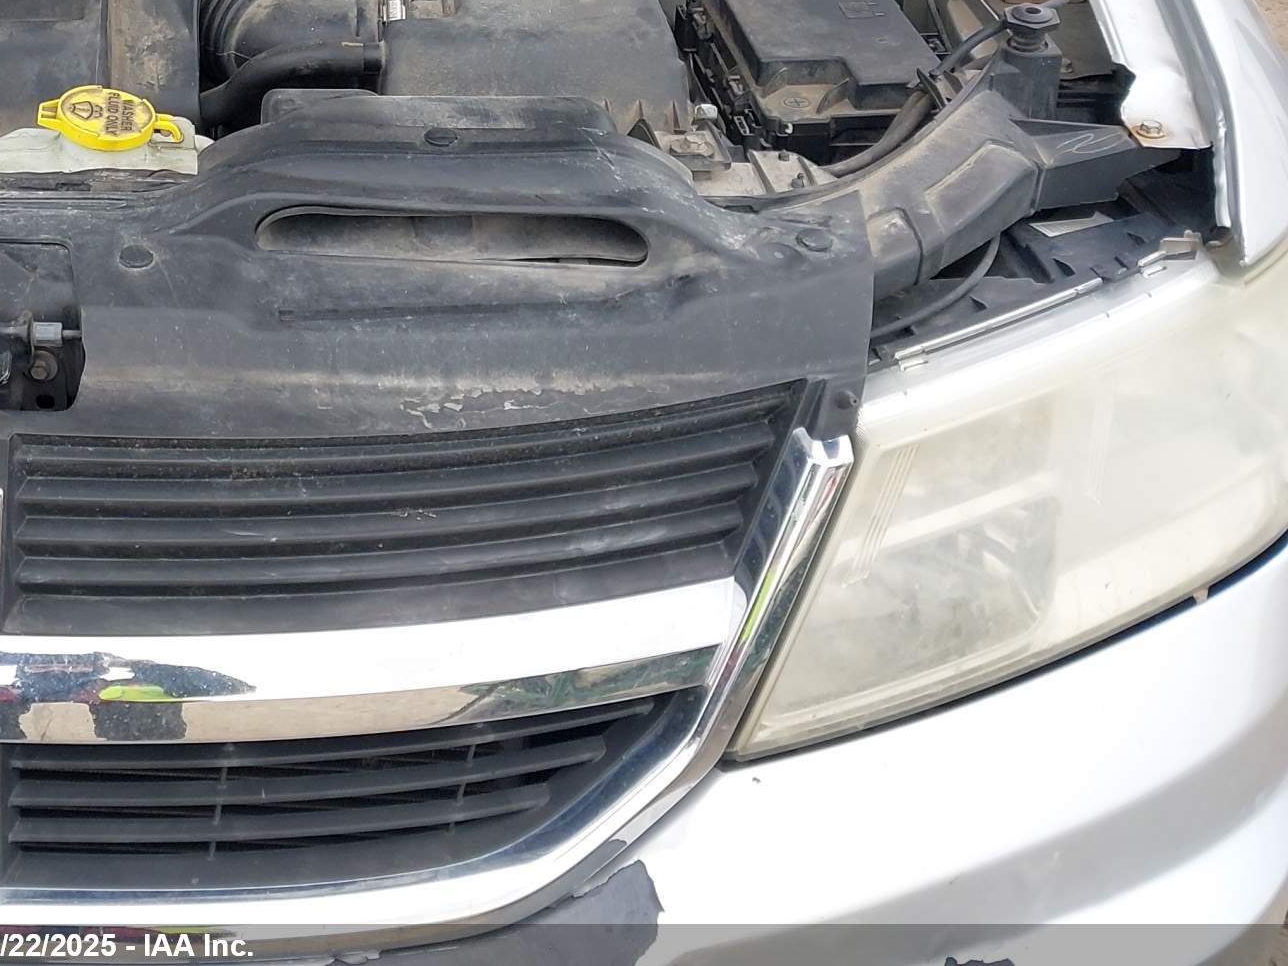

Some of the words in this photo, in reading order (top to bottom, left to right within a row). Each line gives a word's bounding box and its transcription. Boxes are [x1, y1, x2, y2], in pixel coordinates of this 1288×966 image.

[106, 92, 121, 114] FLUID
[104, 114, 119, 137] ONLY
[121, 99, 135, 132] WASHER
